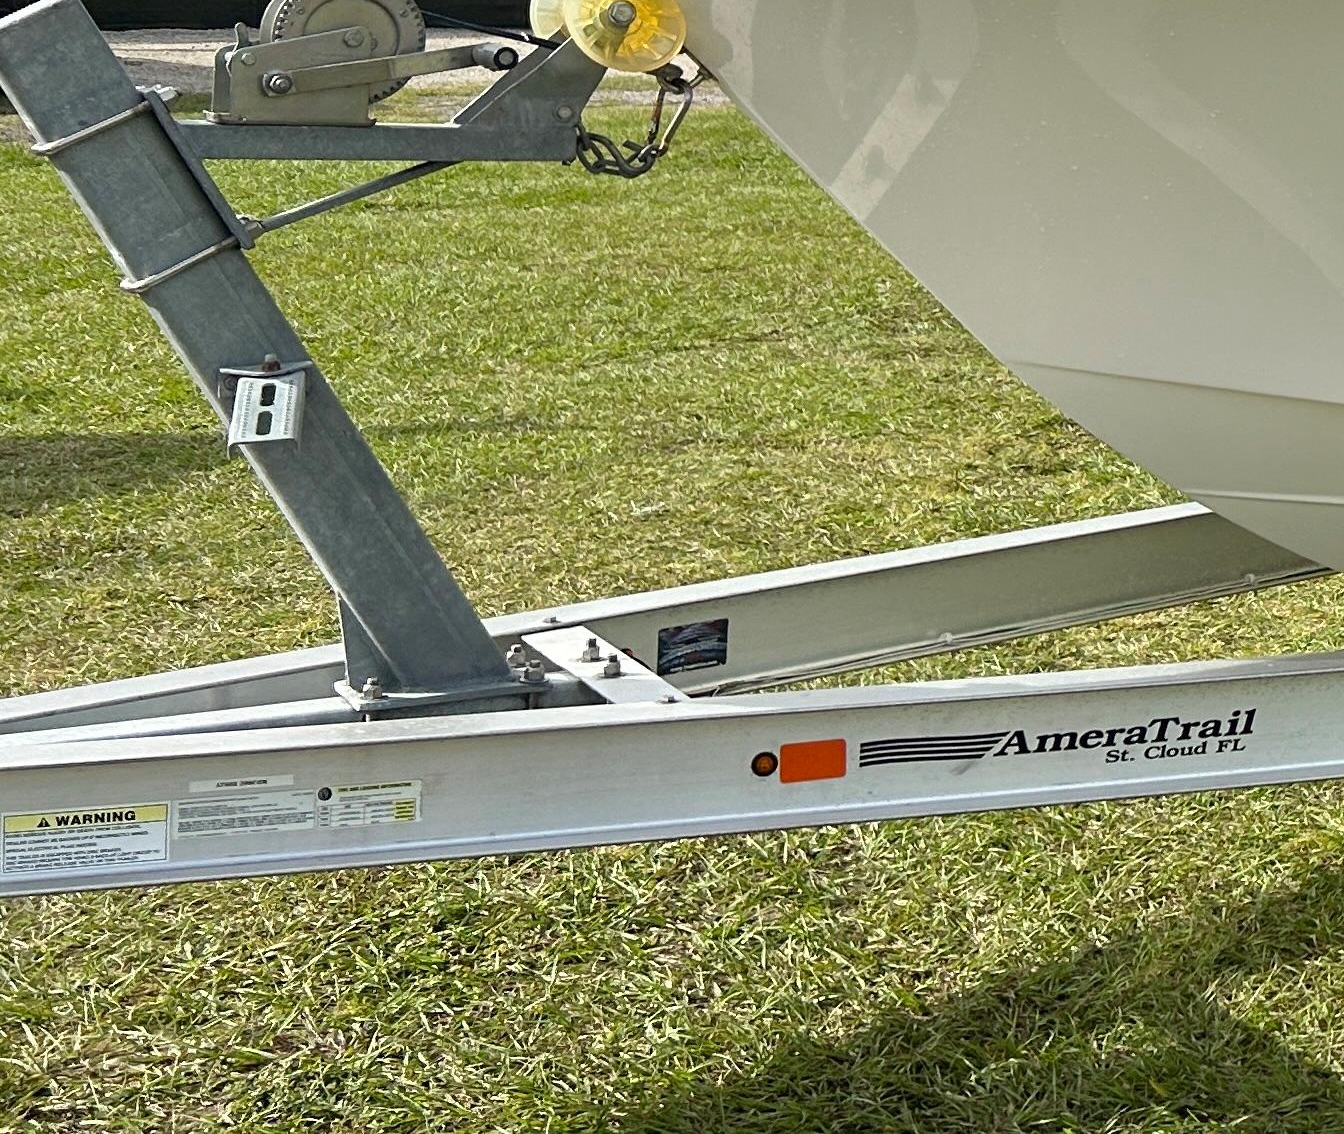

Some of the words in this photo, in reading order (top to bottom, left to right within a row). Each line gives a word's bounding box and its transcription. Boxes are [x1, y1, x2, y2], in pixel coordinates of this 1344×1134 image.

[993, 708, 1257, 757] AmeraTrail
[1105, 749, 1136, 764] St.
[1144, 741, 1208, 760] Cloud
[1215, 738, 1246, 754] FL
[56, 810, 137, 827] WARNING
